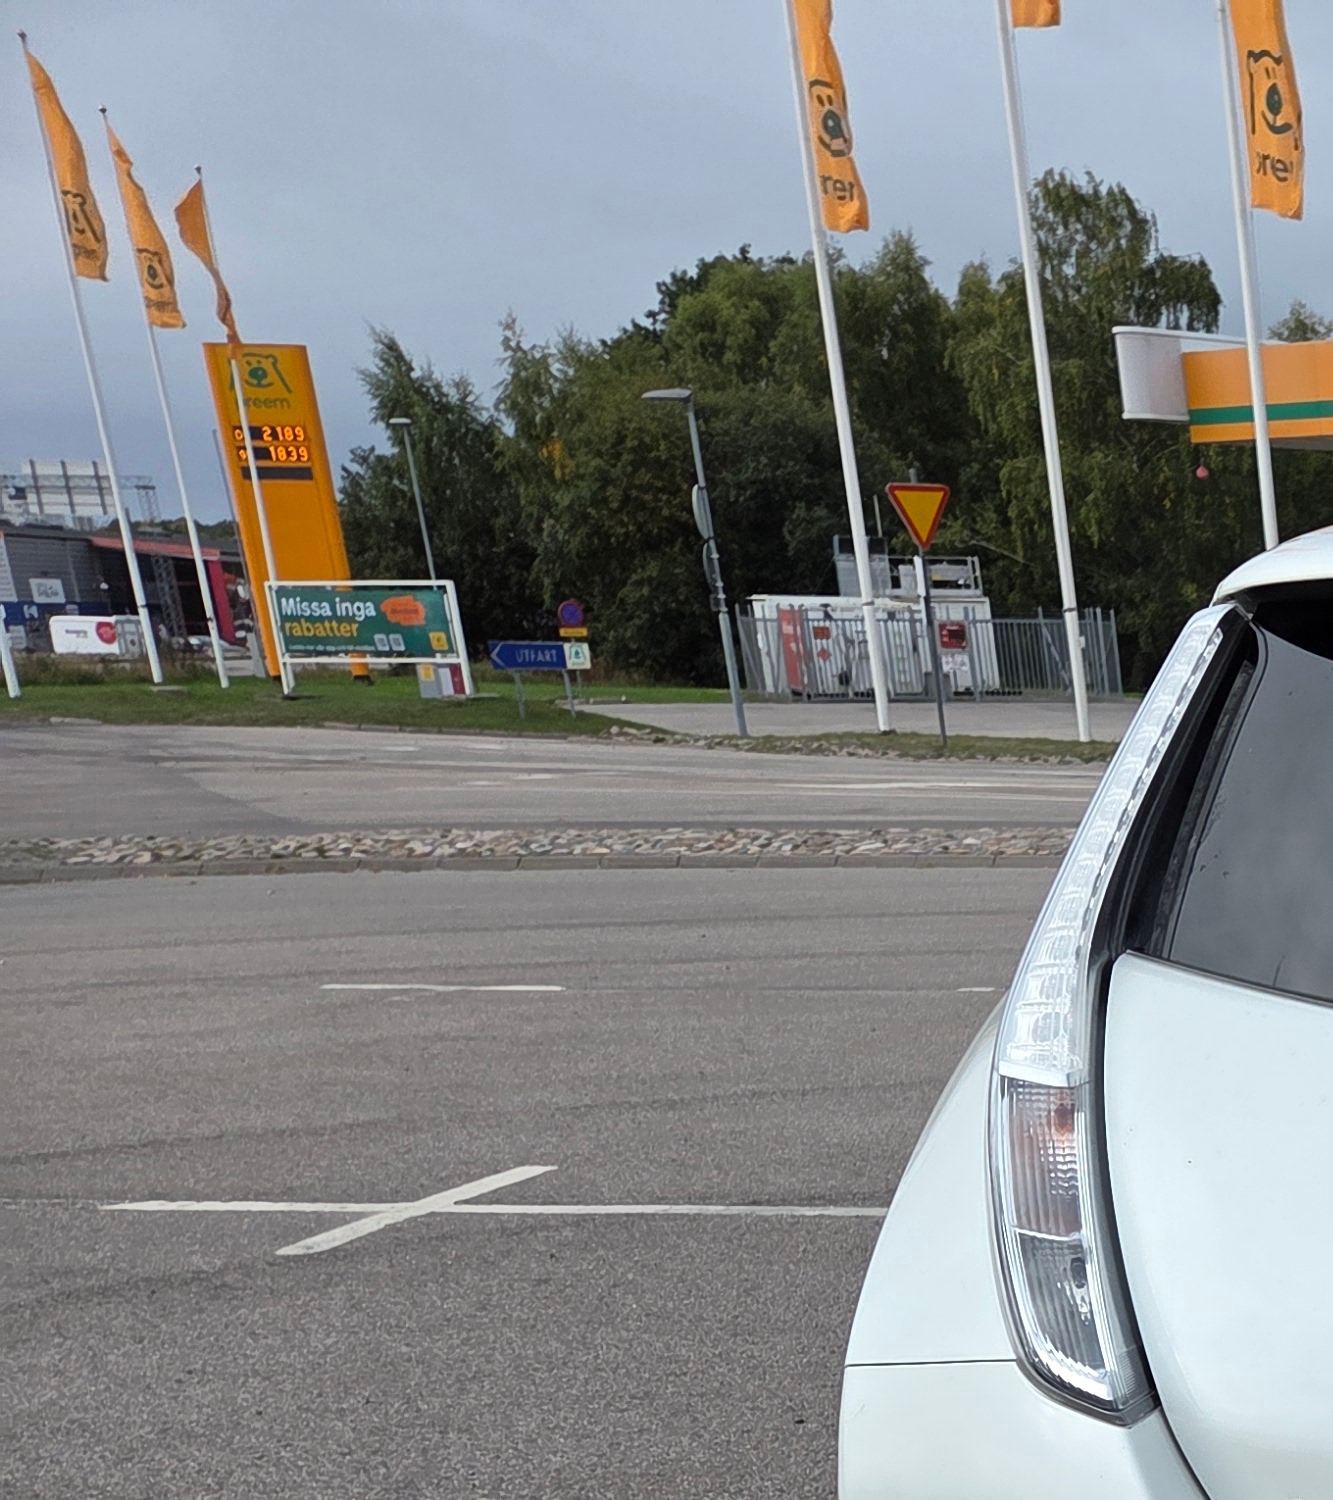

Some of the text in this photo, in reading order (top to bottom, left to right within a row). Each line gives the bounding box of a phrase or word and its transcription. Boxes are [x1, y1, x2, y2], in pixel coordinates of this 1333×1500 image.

[281, 596, 376, 621] Missa inga
[284, 619, 359, 637] rabatter
